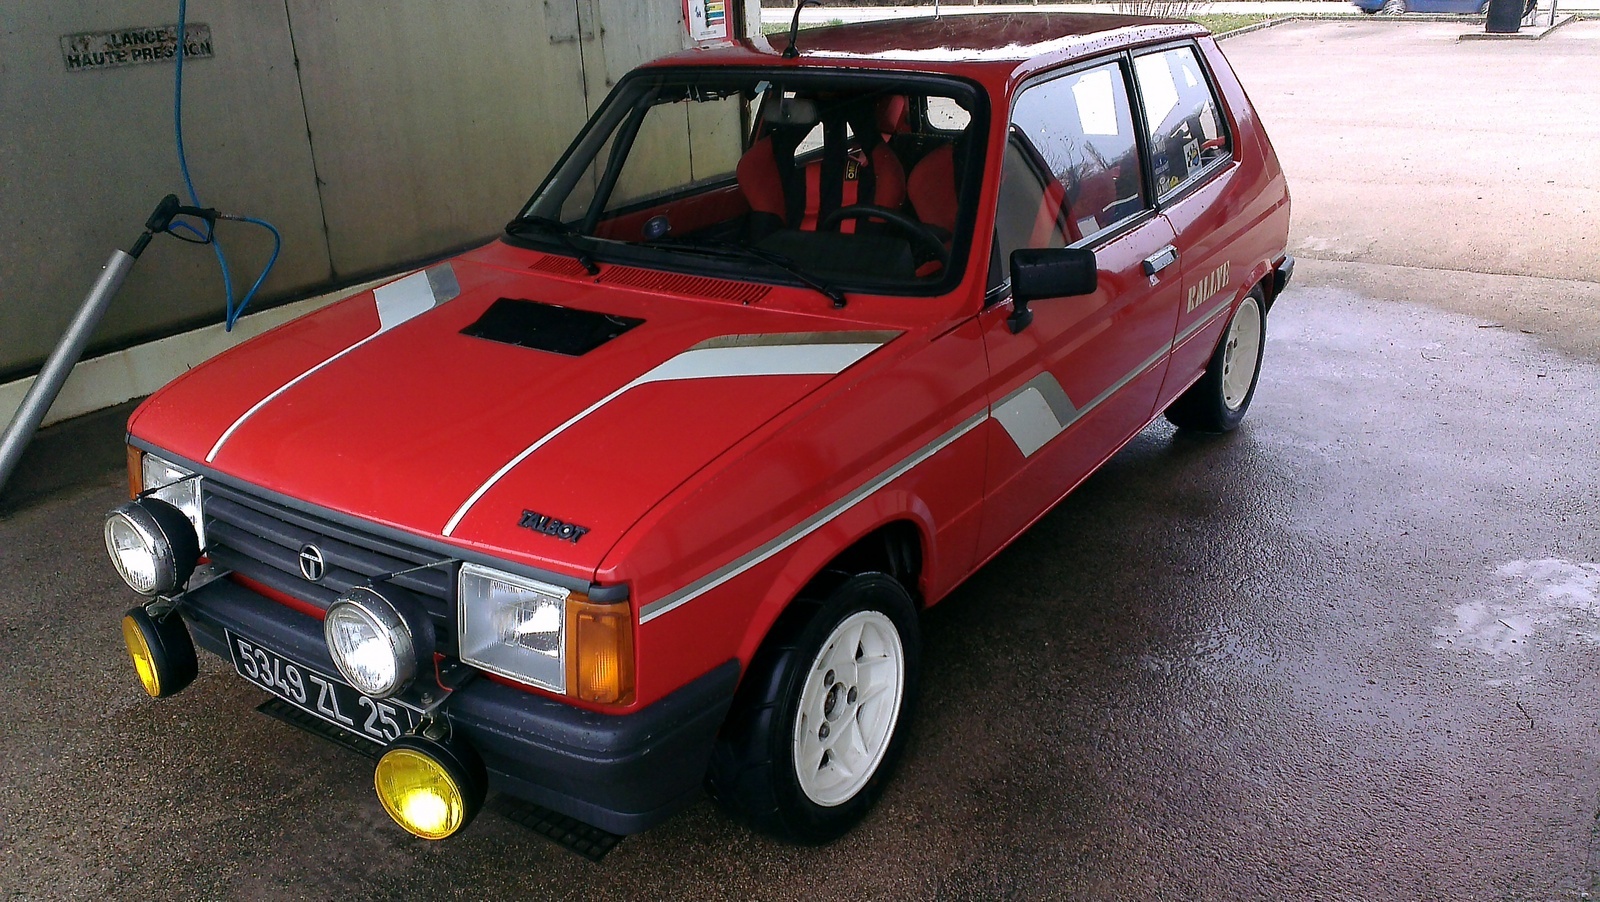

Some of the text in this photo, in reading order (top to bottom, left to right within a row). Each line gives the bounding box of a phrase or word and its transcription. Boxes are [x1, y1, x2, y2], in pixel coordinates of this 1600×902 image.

[110, 30, 168, 48] LANCE
[67, 49, 128, 68] HAUTE
[1187, 260, 1230, 314] RALLYE
[517, 509, 591, 543] TALBOT
[237, 639, 401, 742] 5349 ZL 25
